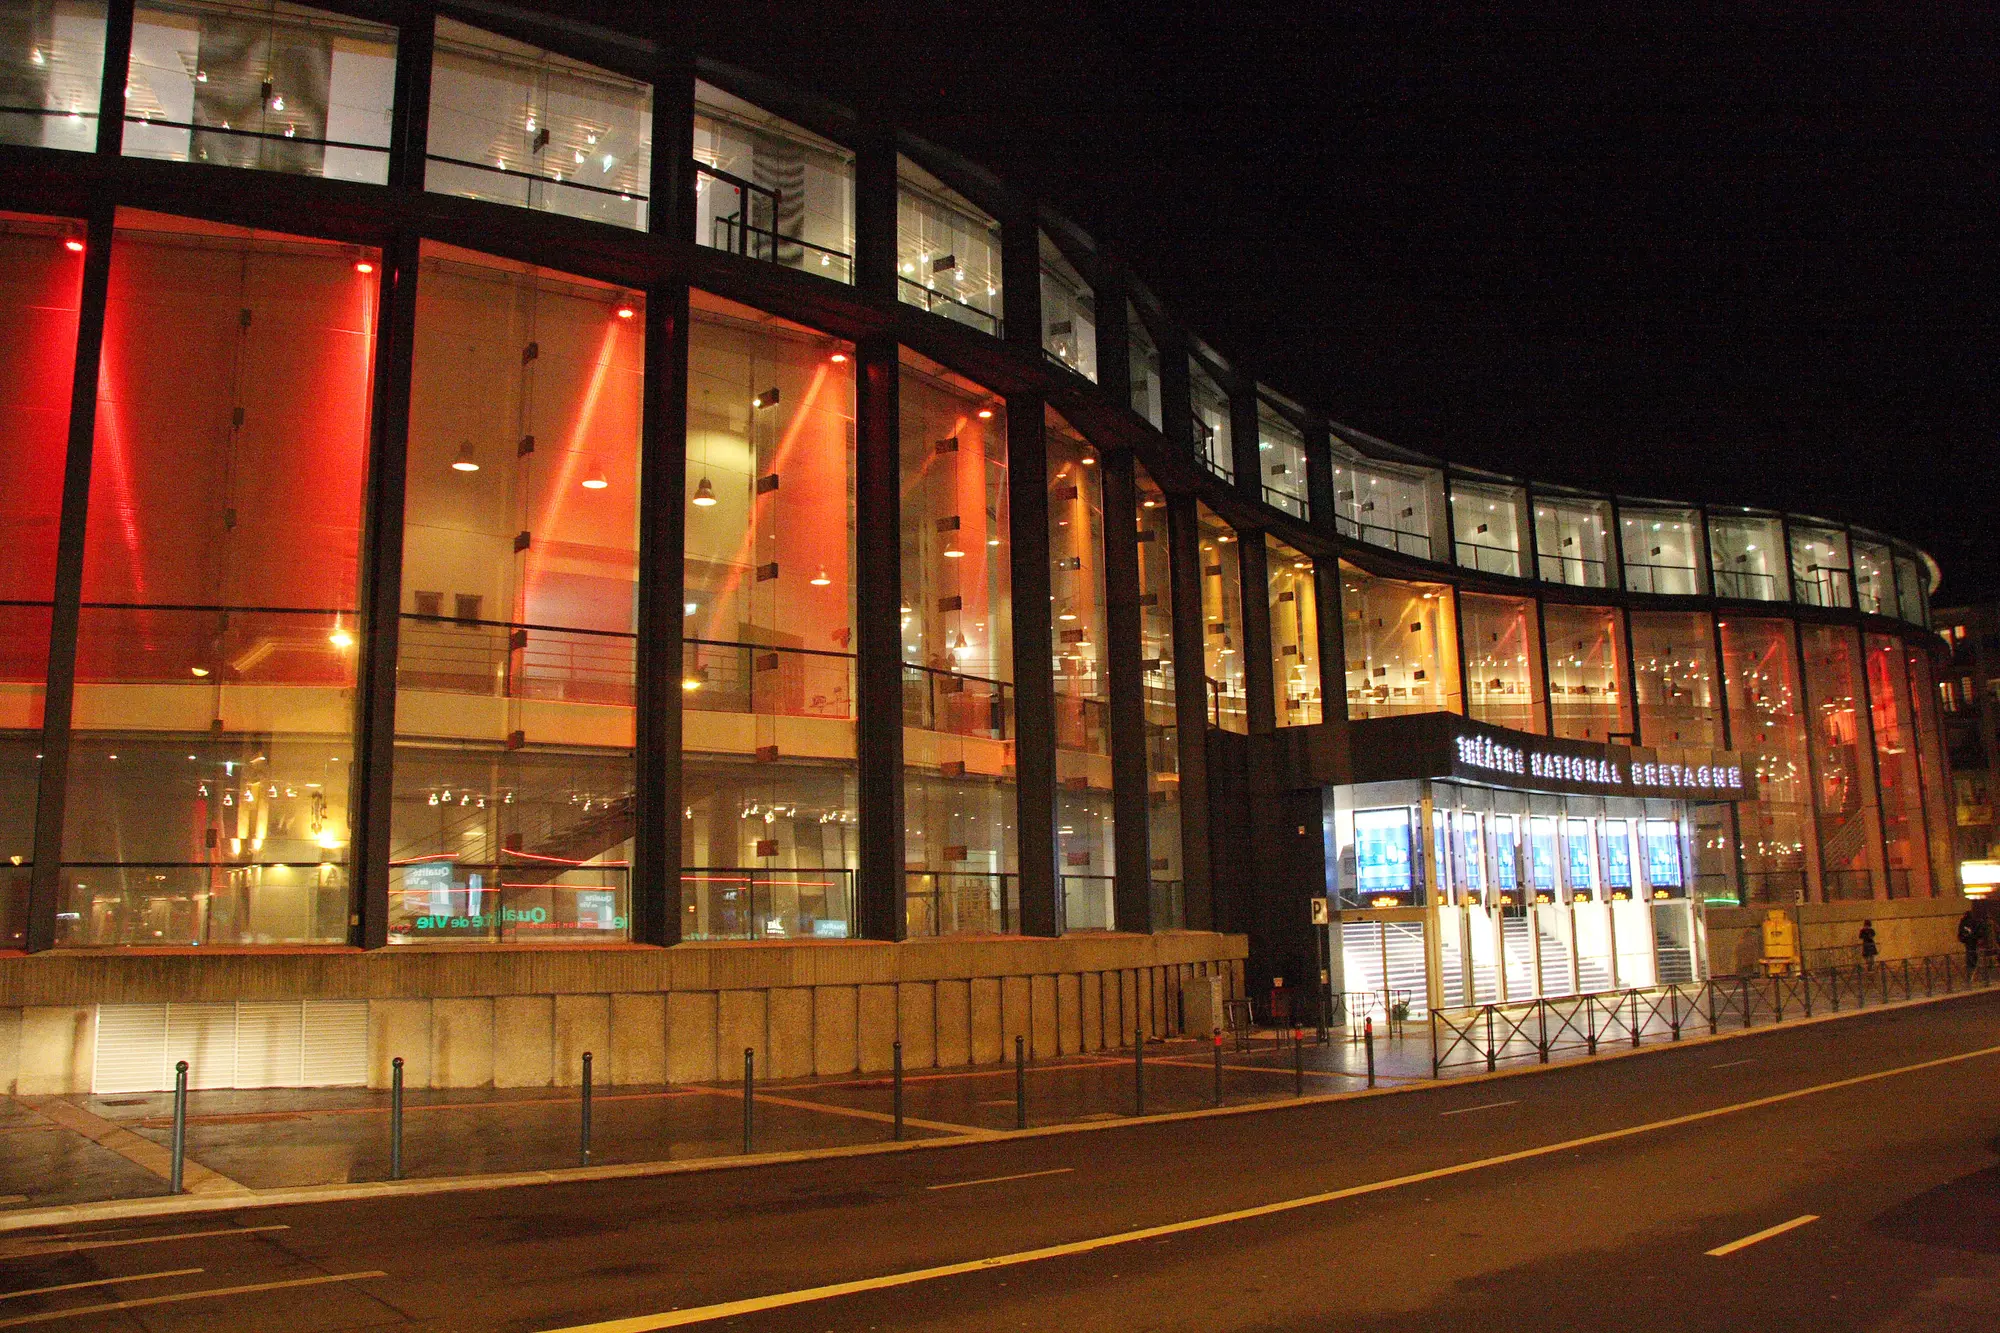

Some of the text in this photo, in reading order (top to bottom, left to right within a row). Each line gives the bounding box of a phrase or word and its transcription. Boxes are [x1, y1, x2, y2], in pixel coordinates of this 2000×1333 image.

[1531, 752, 1622, 784] NATIONAL
[1631, 763, 1742, 788] BRETAGNE
[1313, 901, 1321, 920] P
